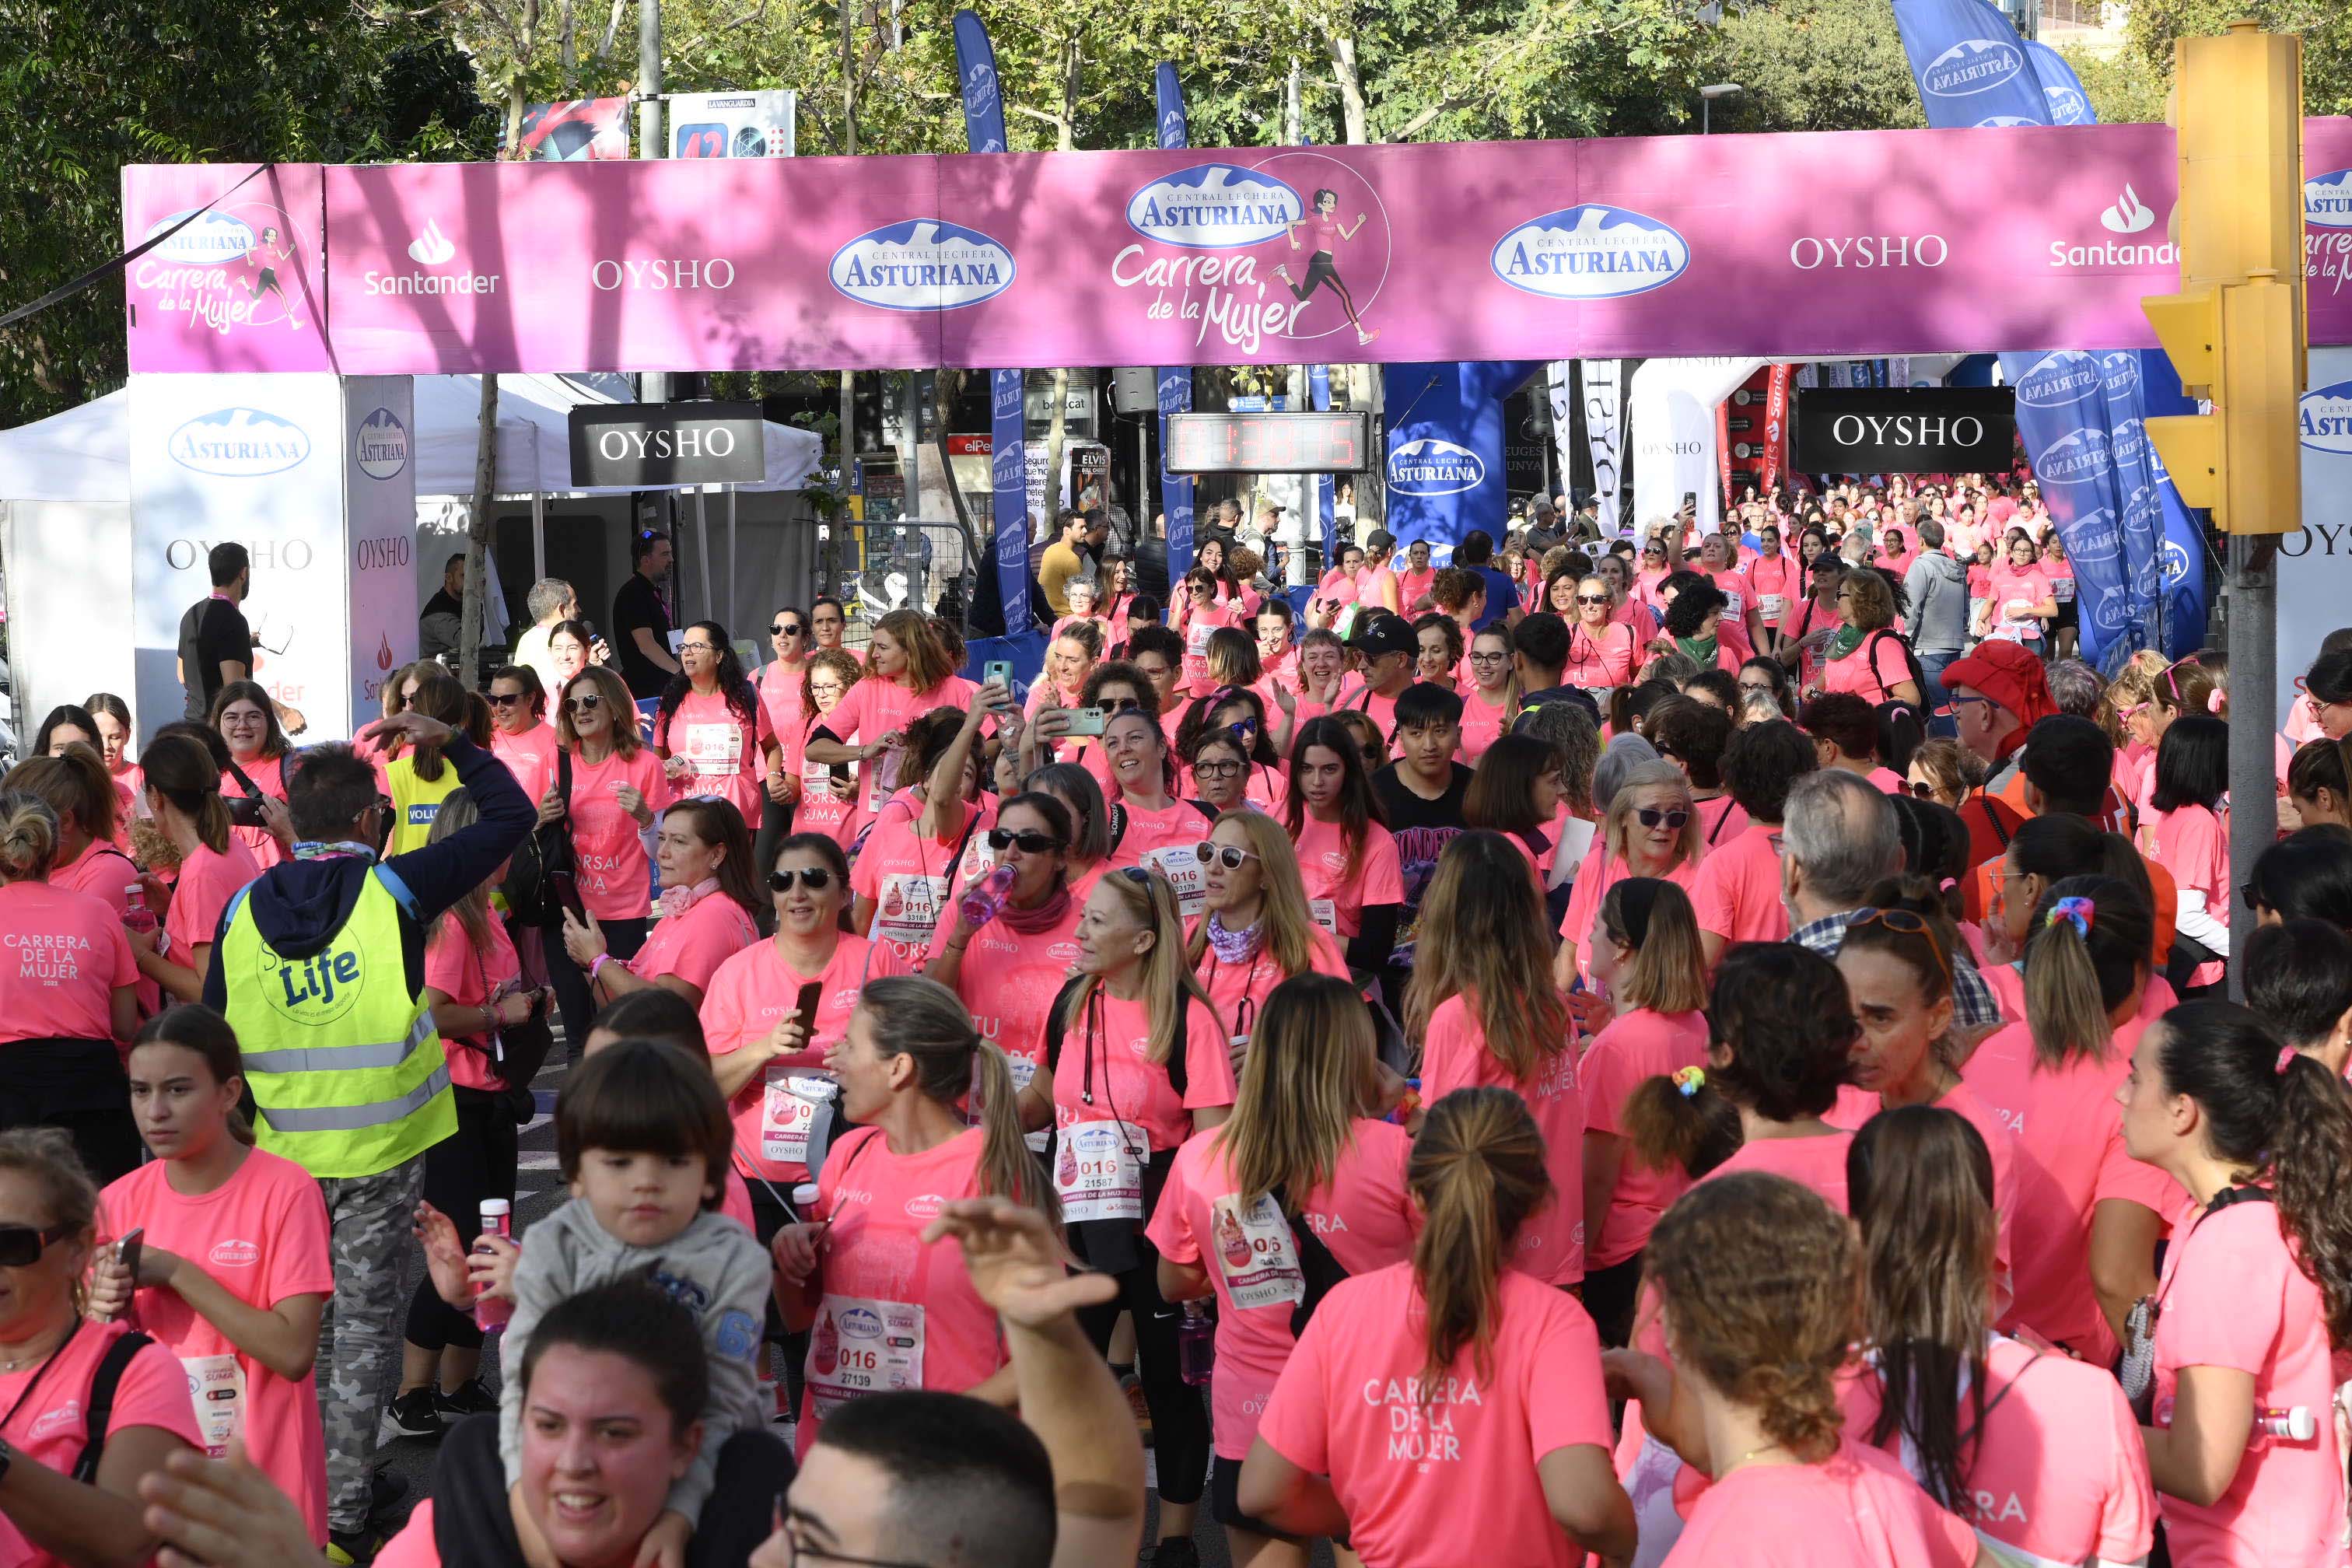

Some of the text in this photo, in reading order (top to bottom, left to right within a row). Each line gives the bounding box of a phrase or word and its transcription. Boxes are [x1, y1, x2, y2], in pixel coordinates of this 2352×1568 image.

[1167, 191, 1284, 202] CENTRAL LECHERA
[1139, 195, 1289, 227] ASTURIANA
[1538, 236, 1668, 247] CENTRAL LECHERA
[872, 250, 995, 261] CENTRAL LECHERA
[1506, 241, 1675, 275] ASTURIANA
[1790, 234, 1948, 269] OYSHO
[843, 254, 1003, 287] ASTURIANA
[1111, 243, 1258, 287] Carrera
[135, 261, 228, 289] Carrera
[592, 258, 735, 290] OYSHO
[364, 271, 499, 296] Santander
[158, 286, 262, 335] de la Mujer
[1147, 281, 1312, 355] de la Mujer
[1832, 415, 1983, 447] OYSHO
[180, 433, 300, 459] ASTURIANA
[360, 436, 405, 463] ASTURIANA
[600, 427, 734, 460] OYSHO
[1082, 454, 1106, 465] ELVIS
[1390, 462, 1478, 483] ASTURIANA
[358, 535, 408, 570] OYSHO
[1573, 672, 1587, 682] TU
[684, 783, 725, 796] SUMA
[804, 809, 840, 820] SUMA
[884, 859, 915, 867] OYSHO
[1171, 870, 1197, 884] 016
[906, 901, 931, 912] 016
[4, 934, 91, 950] CARRERA
[980, 939, 1019, 953] OYSHO
[23, 949, 75, 964] DE LA
[19, 964, 79, 980] MUJER
[279, 947, 360, 1007] Life
[971, 1016, 999, 1038] TU
[771, 1146, 803, 1155] OYSHO
[1079, 1139, 1117, 1149] ASTURIANA
[1081, 1160, 1118, 1175] 016
[1084, 1178, 1113, 1188] 21587
[1062, 1192, 1087, 1202] CARRERA
[214, 1250, 257, 1260] ASTURIANA
[1241, 1286, 1277, 1301] OYSHO
[843, 1318, 880, 1334] ASTURIANA
[887, 1318, 914, 1328] SUMA
[719, 1308, 754, 1357] 6
[840, 1348, 877, 1370] 016
[205, 1374, 235, 1382] SUMA
[841, 1373, 871, 1387] 27139
[1390, 1405, 1454, 1433] DE LA
[1387, 1432, 1461, 1461] MUJER
